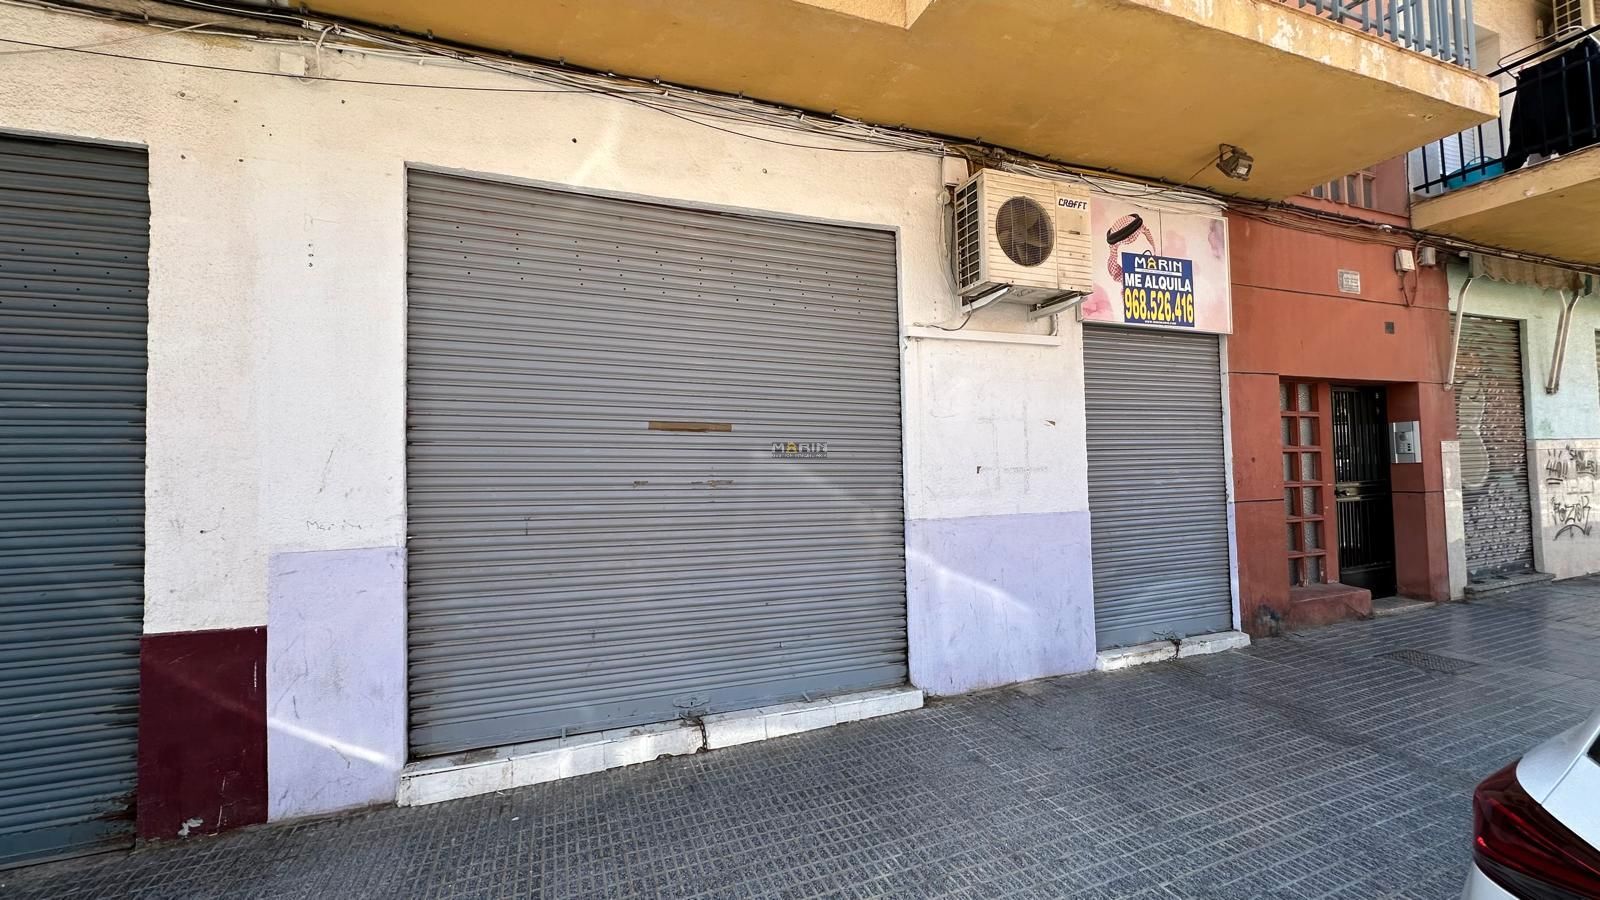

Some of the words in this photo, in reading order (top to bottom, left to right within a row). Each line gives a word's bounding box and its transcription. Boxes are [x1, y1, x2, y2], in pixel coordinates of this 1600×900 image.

[1124, 272, 1142, 288] ME
[1144, 274, 1192, 293] ALQUILA
[1124, 287, 1194, 324] 968.526.416
